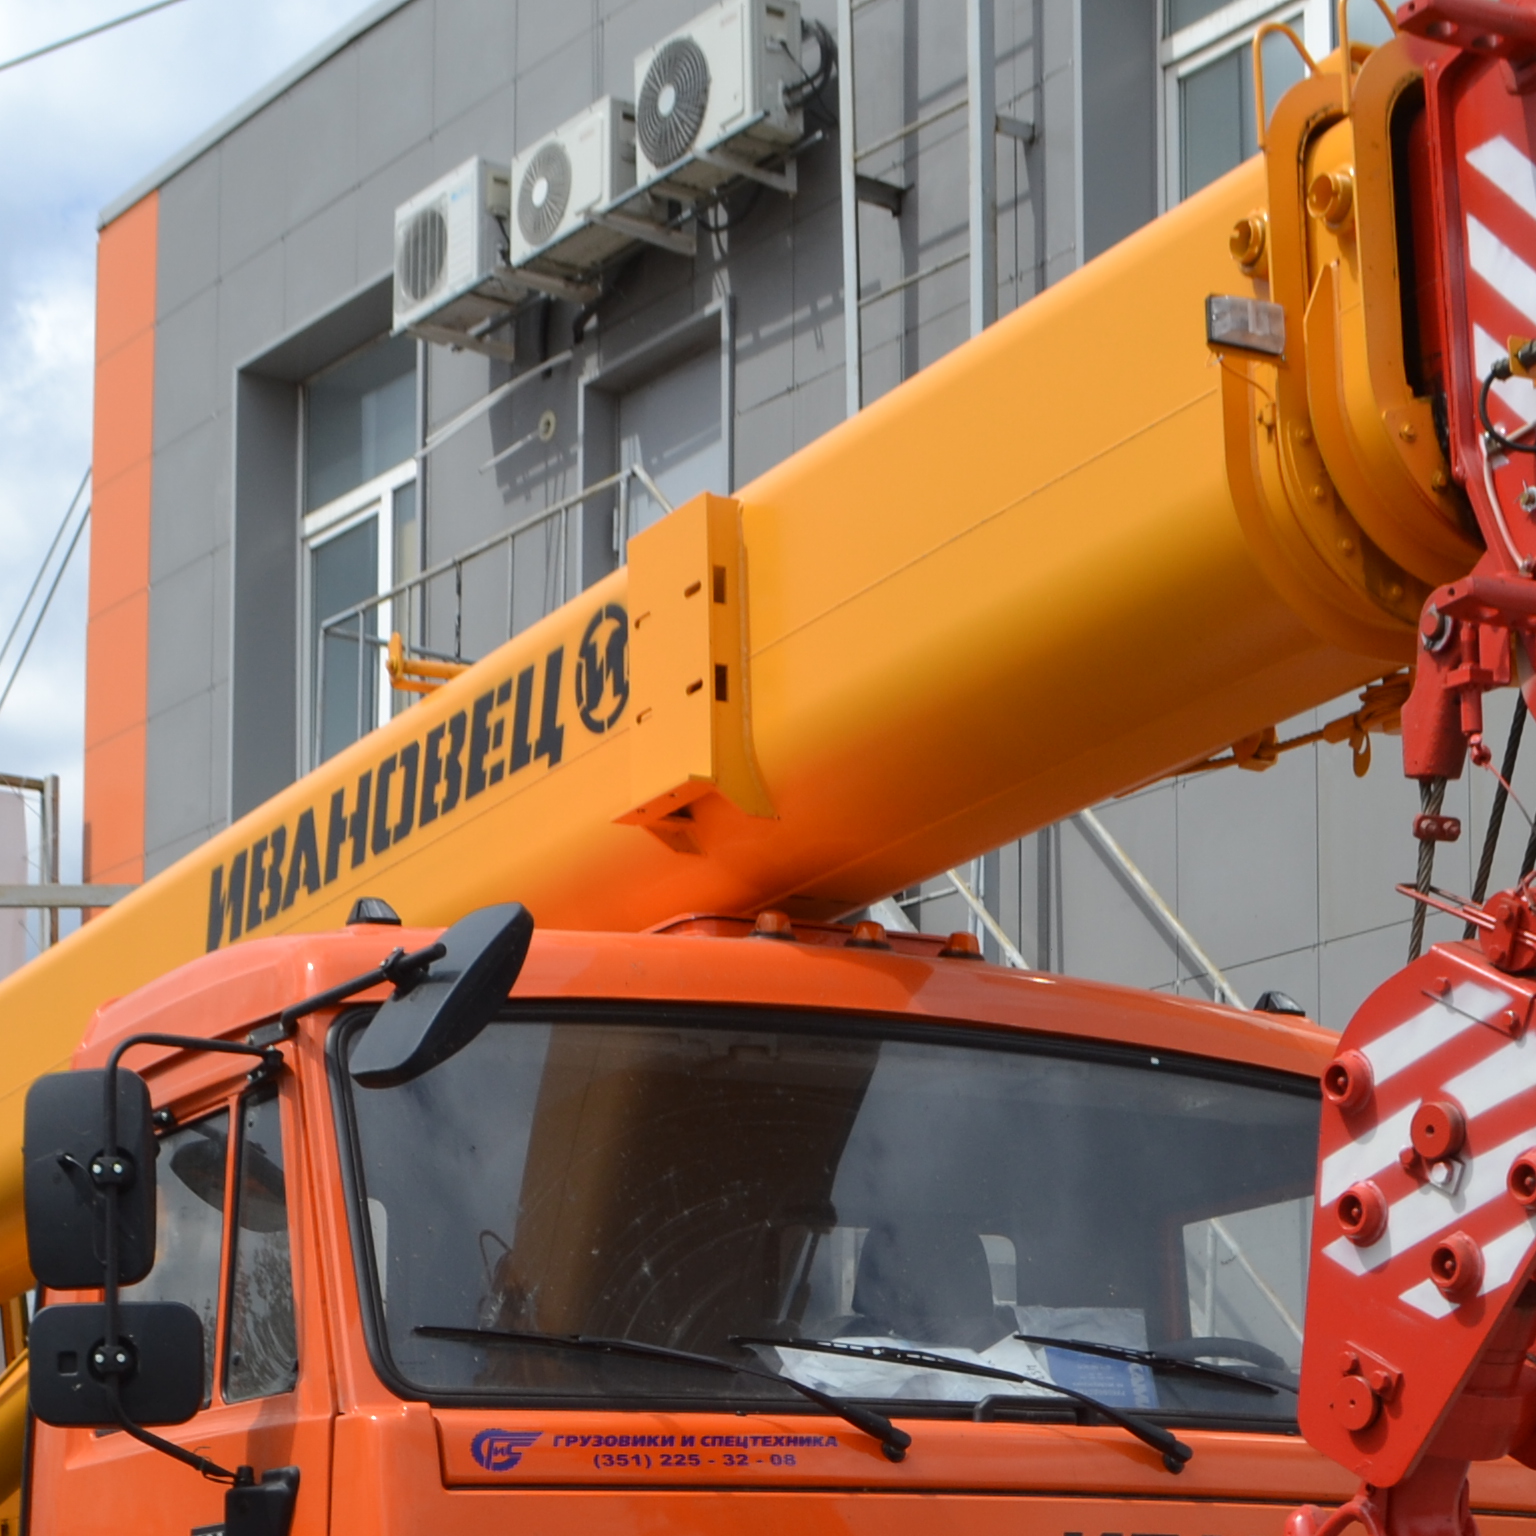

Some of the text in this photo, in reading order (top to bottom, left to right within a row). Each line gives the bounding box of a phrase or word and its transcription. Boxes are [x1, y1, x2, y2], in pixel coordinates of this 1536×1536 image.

[206, 645, 565, 953] ИВАНОВЕЦ
[552, 1434, 838, 1449] ГРУЗОВИКИ И СПЕЦТЕХНИКА
[593, 1453, 652, 1469] (351)
[659, 1454, 701, 1467] 225
[723, 1454, 749, 1466] 32
[769, 1454, 796, 1466] 08
